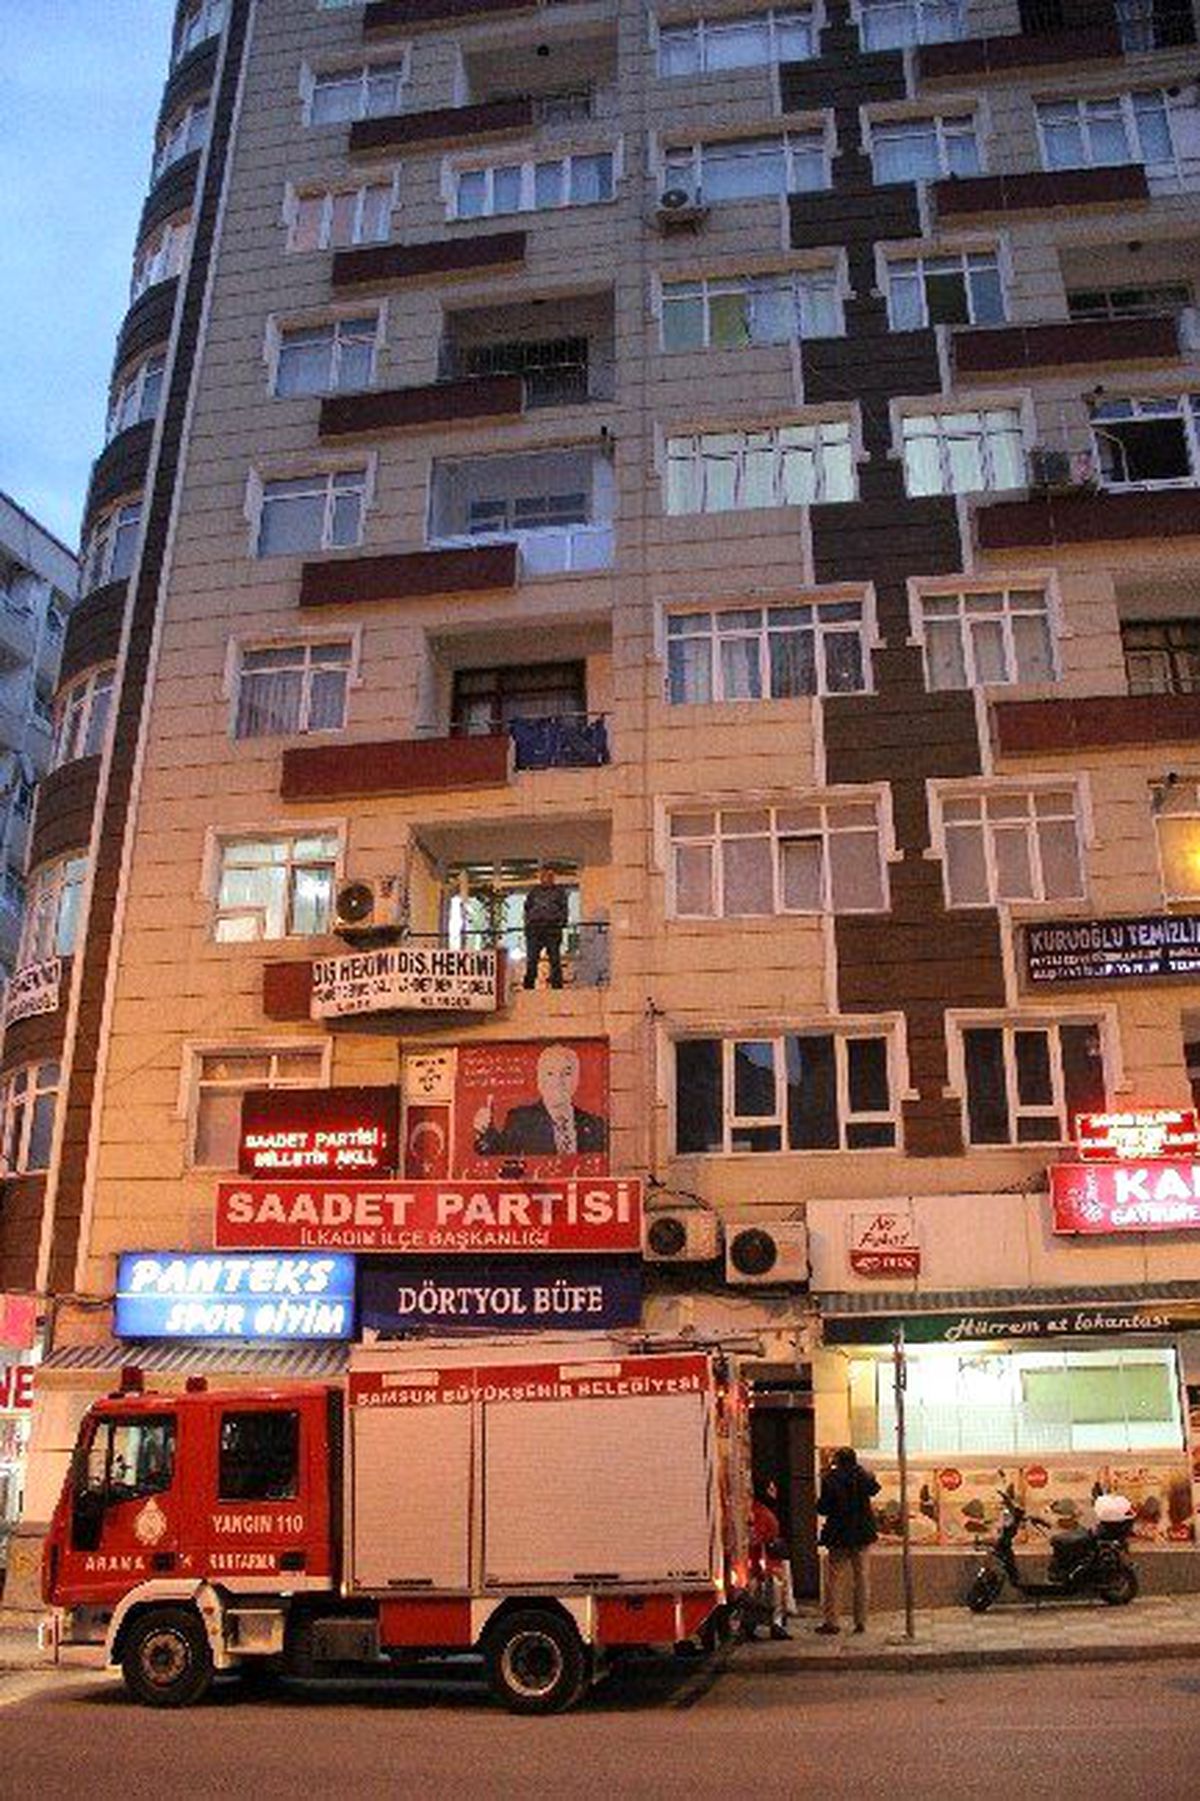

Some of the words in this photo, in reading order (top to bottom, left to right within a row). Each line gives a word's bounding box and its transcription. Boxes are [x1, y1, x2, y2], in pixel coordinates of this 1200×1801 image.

[1114, 1165, 1200, 1204] KA
[226, 1191, 417, 1226] SAADET
[436, 1183, 630, 1226] PARTİSİ
[300, 1226, 375, 1247] İLKADIM
[381, 1226, 424, 1251] İLÇE
[429, 1228, 550, 1251] BAŞKANLIĞI
[129, 1258, 335, 1294] PANTEKS
[398, 1280, 527, 1315] DÖRTYOL
[533, 1280, 604, 1313] BÜFE
[166, 1303, 244, 1335] SPOR
[252, 1298, 345, 1335] GİYİM
[357, 1389, 438, 1407] SAMSUN
[212, 1514, 273, 1534] YANGIN
[276, 1514, 304, 1534] 110
